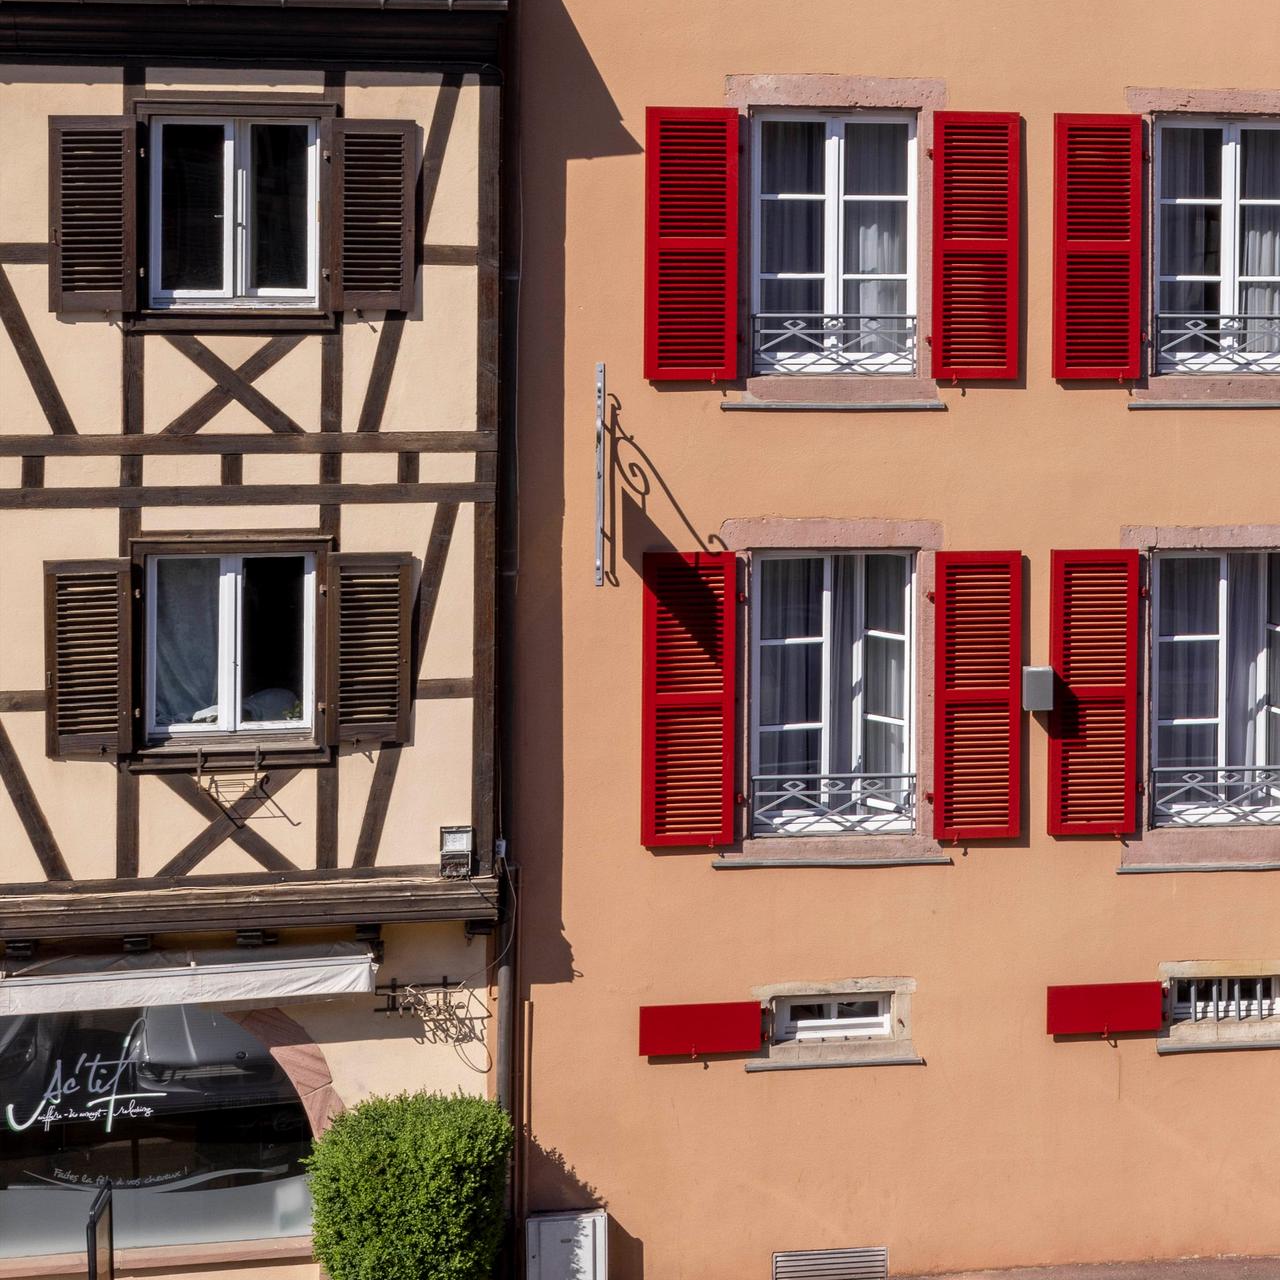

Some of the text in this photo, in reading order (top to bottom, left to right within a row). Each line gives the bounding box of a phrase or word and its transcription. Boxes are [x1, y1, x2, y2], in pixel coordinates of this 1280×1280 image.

[53, 1167, 79, 1183] Faites
[126, 1177, 141, 1187] vos
[144, 1170, 182, 1184] cheveux
